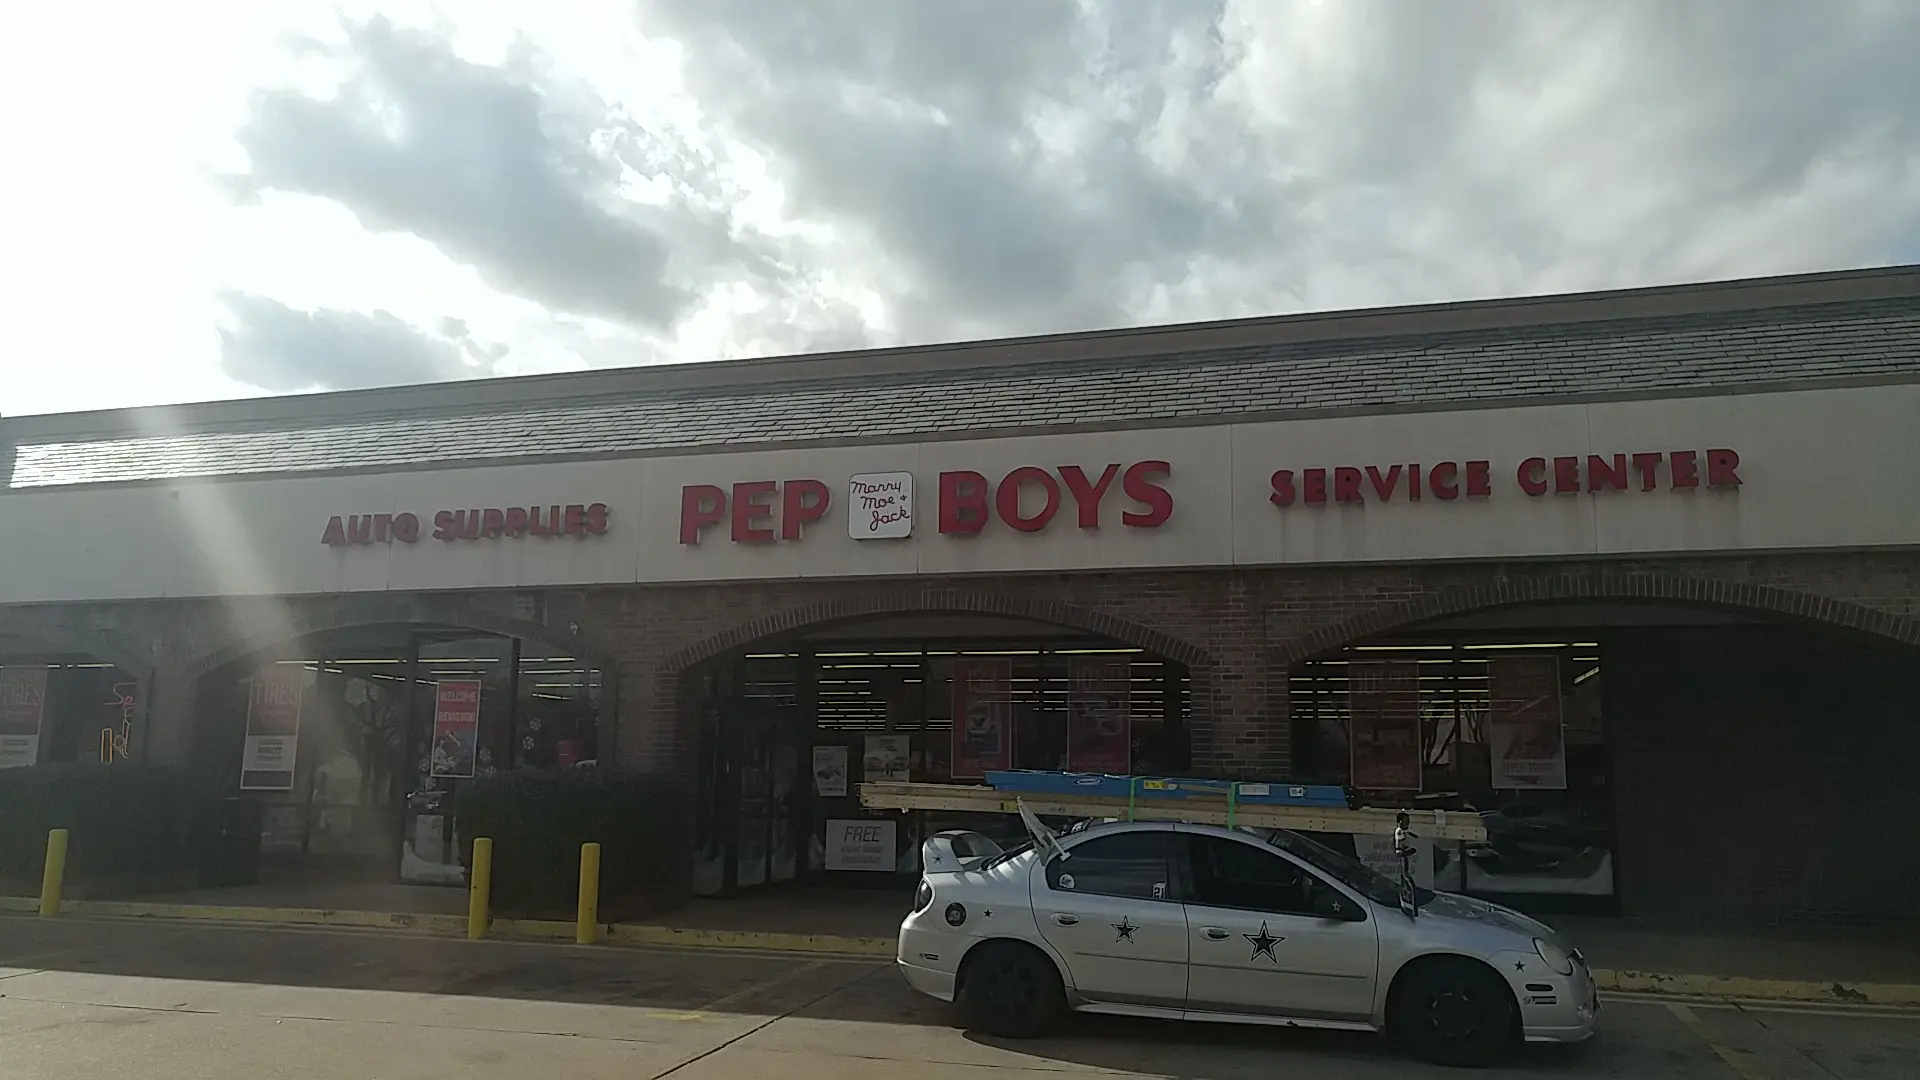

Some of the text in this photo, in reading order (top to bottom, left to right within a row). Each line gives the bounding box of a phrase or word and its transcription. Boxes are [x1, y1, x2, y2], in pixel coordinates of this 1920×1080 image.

[1270, 448, 1743, 505] SERVICE CENTER
[680, 460, 1174, 545] PEP BOYS
[860, 496, 895, 510] Moe
[321, 502, 609, 547] AUTO SUPPLIES
[869, 505, 910, 531] Jack
[440, 690, 477, 702] WELCOME
[844, 826, 882, 842] FREE
